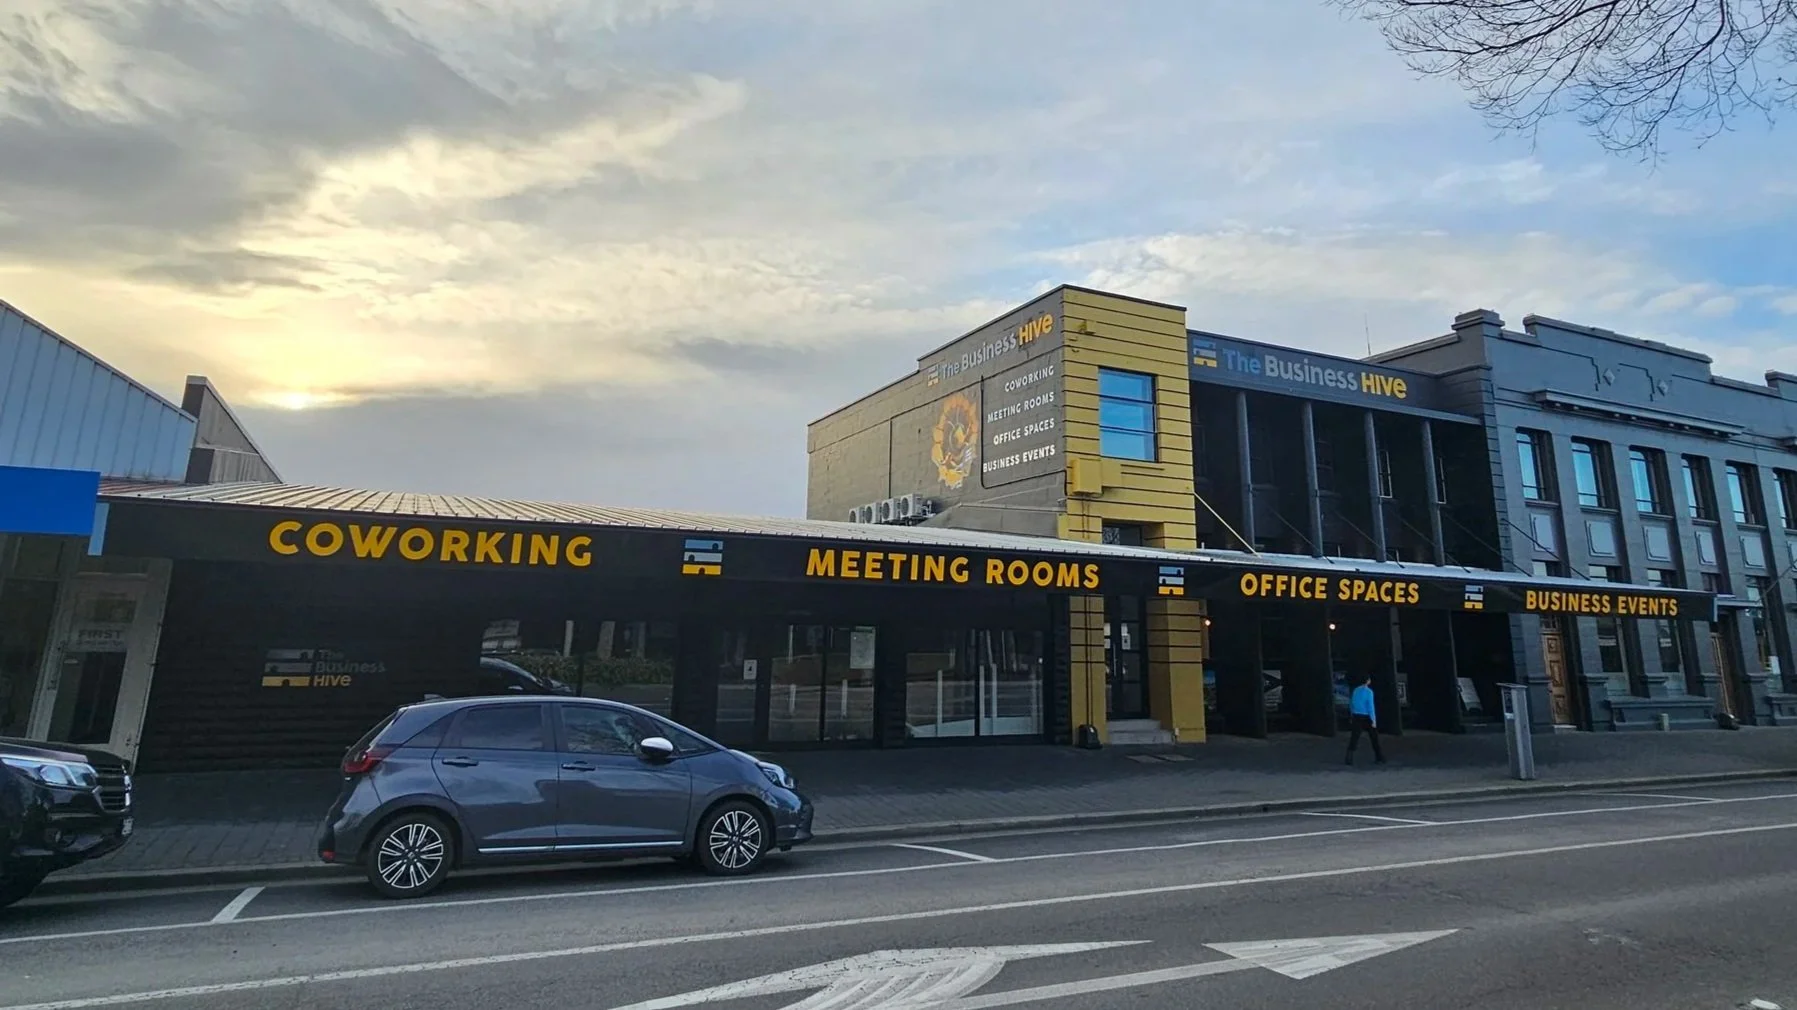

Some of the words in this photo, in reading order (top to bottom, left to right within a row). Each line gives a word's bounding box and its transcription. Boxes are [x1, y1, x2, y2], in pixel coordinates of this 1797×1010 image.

[942, 362, 959, 379] The
[961, 332, 1017, 373] Business
[1222, 348, 1261, 374] The
[1264, 354, 1358, 391] Business
[1004, 365, 1054, 393] COWORKING
[987, 403, 1021, 423] MEETING
[1024, 391, 1055, 411] ROOMS
[993, 428, 1021, 445] OFFICE
[1024, 418, 1055, 436] SPACES
[983, 454, 1020, 473] BUSINESS
[1022, 444, 1056, 463] EVENTS
[269, 520, 593, 567] COWORKING
[806, 547, 969, 583] MEETING
[986, 558, 1100, 589] ROOMS
[1240, 572, 1328, 599] OFFICE
[1339, 578, 1420, 604] SPACES
[1526, 590, 1611, 613] BUSINESS
[1617, 595, 1679, 616] EVENTS
[78, 629, 124, 639] FIRST
[315, 660, 387, 673] Business
